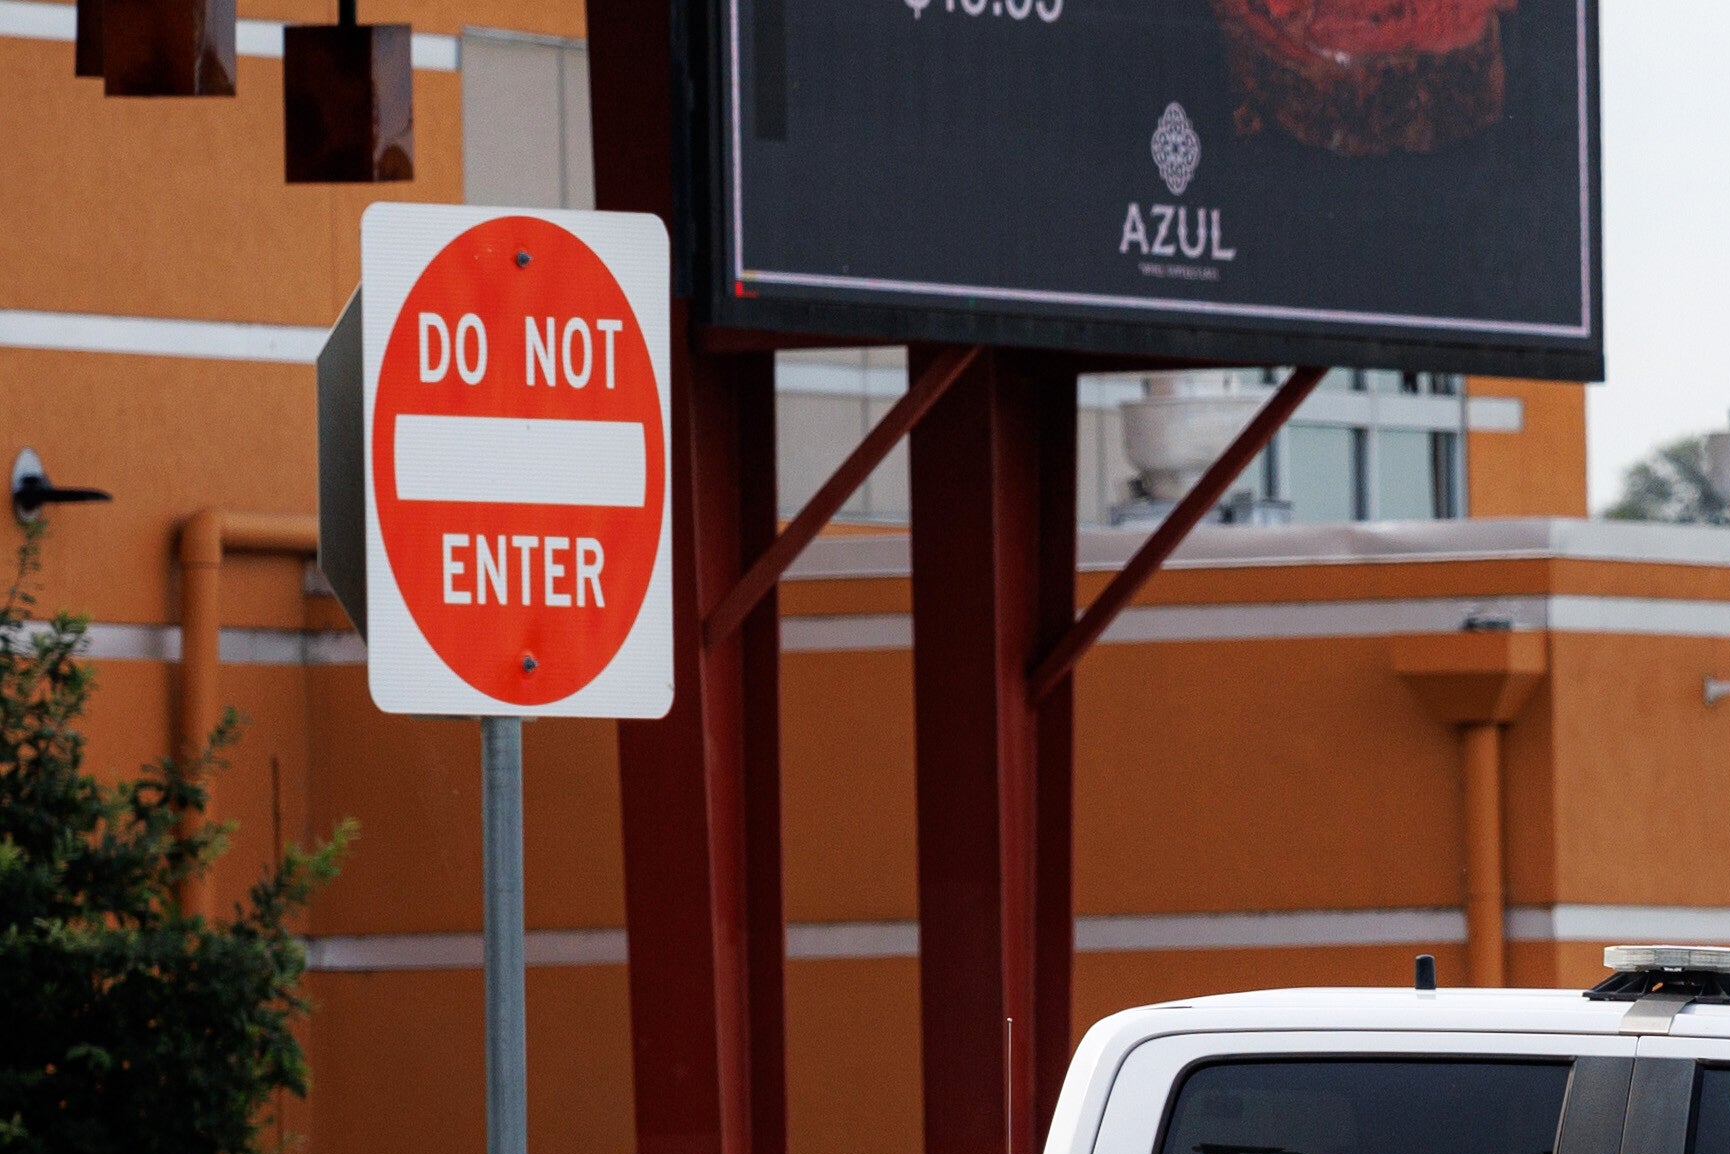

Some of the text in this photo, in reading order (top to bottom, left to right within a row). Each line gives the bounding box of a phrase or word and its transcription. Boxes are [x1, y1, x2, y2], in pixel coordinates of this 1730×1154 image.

[1119, 203, 1237, 262] AZUL
[418, 312, 624, 390] DO NOT
[442, 533, 606, 608] ENTER
